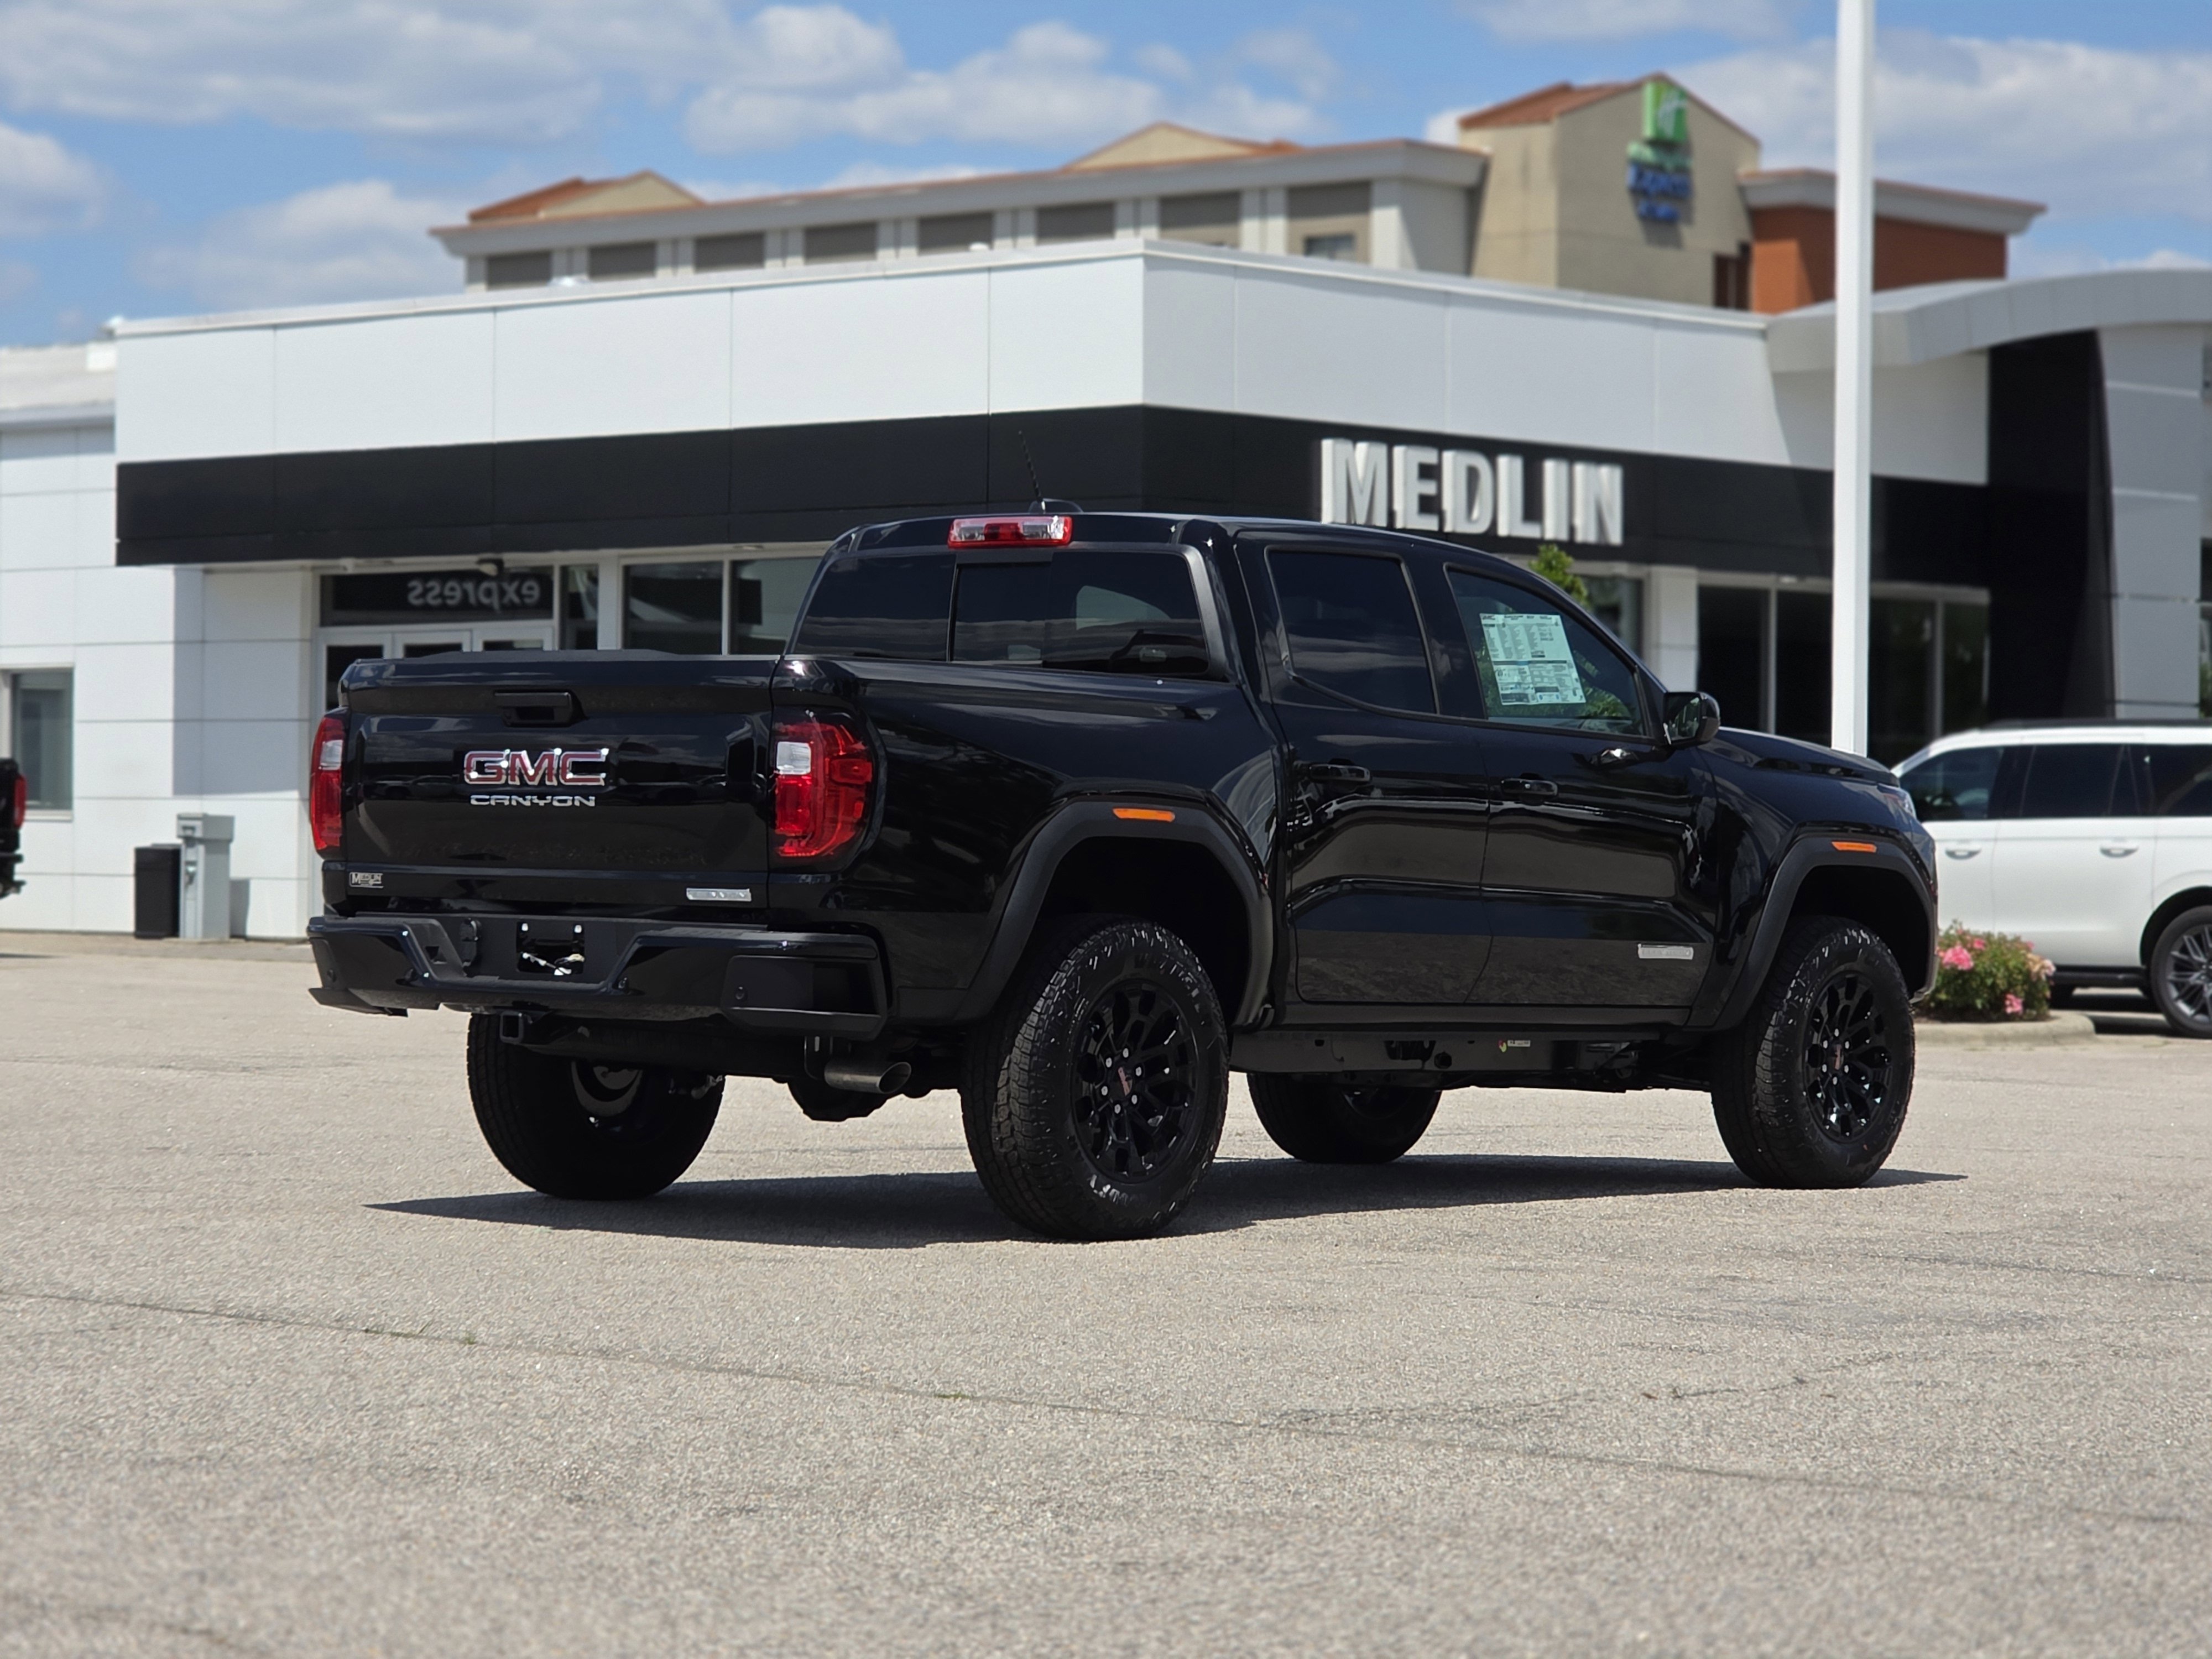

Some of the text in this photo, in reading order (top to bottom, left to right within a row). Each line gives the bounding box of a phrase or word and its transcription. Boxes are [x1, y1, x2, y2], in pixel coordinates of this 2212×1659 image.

[1321, 438, 1624, 546] MEDLIN
[463, 748, 609, 786] GMC
[470, 795, 596, 807] CANYON
